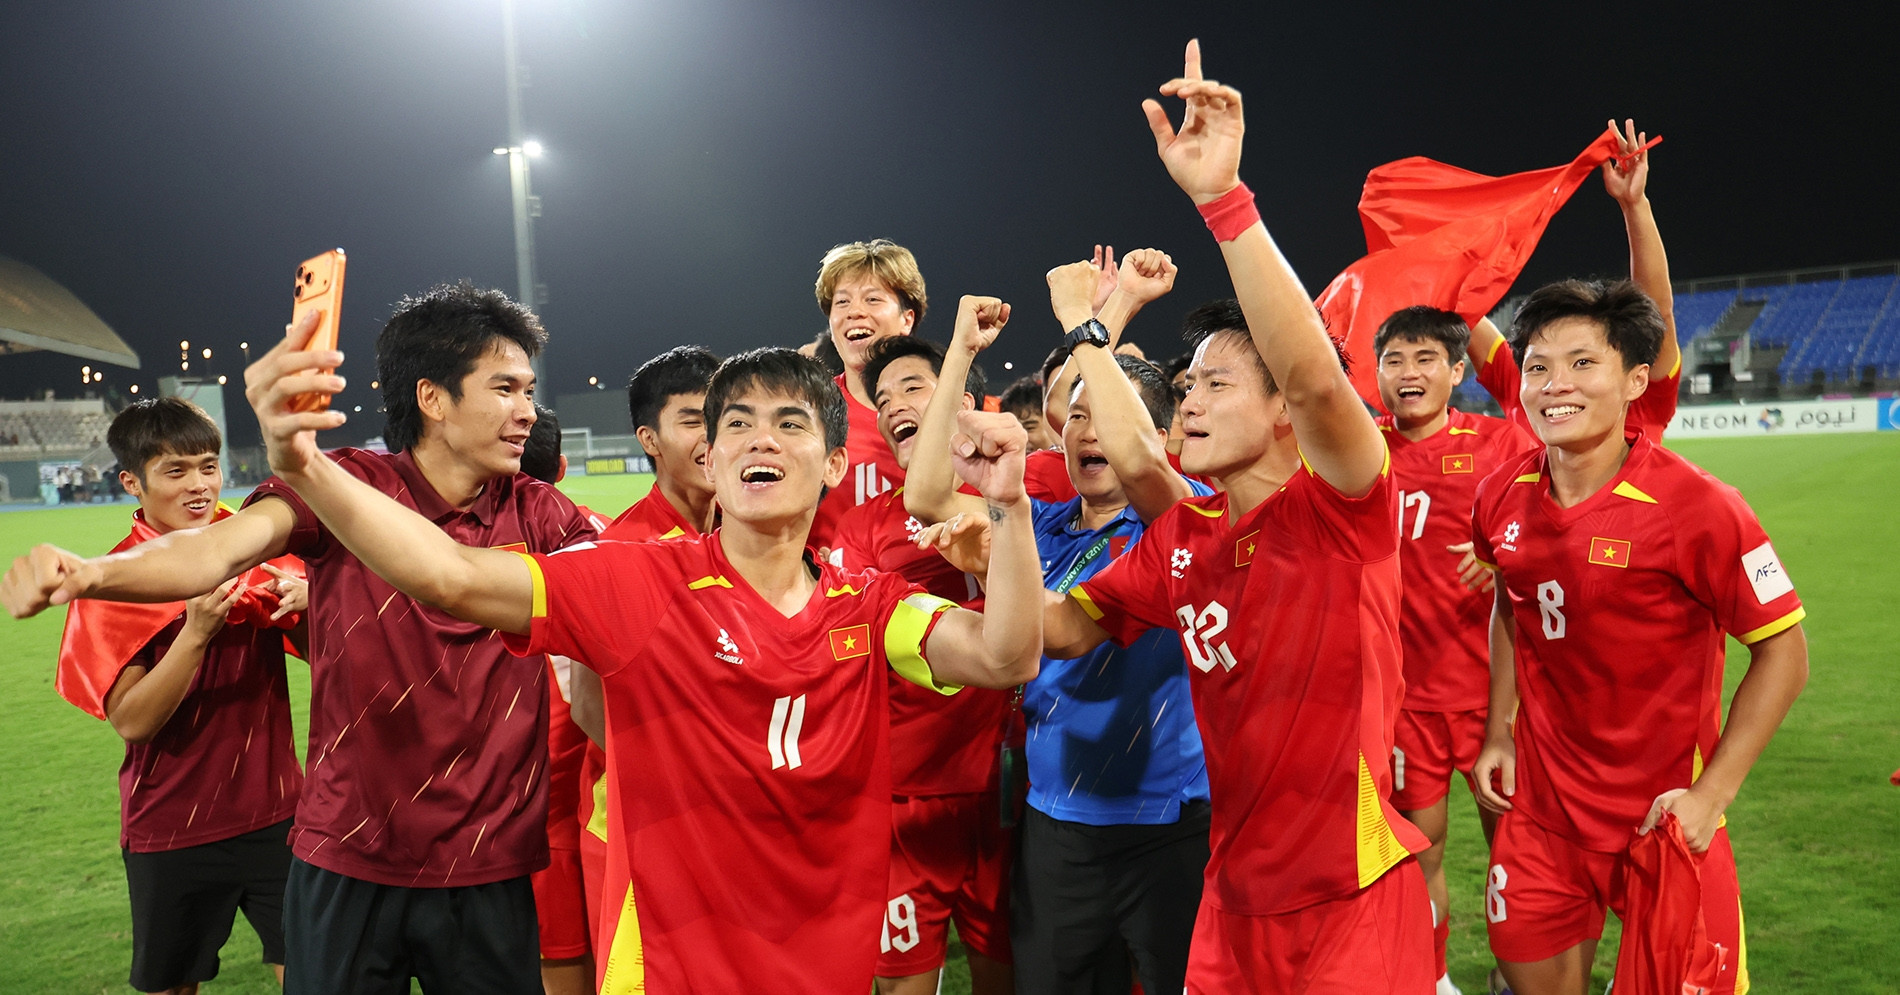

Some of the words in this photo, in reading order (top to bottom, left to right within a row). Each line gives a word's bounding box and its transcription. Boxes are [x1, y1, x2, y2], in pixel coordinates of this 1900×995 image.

[1681, 414, 1748, 430] NEOM
[1795, 406, 1857, 429] نيوم
[1398, 489, 1431, 541] 17
[1066, 557, 1086, 582] ASIAN
[1085, 545, 1101, 560] U23
[1755, 561, 1778, 583] AFC
[1537, 579, 1566, 640] 8
[1176, 600, 1237, 673] 22
[767, 693, 807, 771] 11
[1486, 863, 1508, 924] 8
